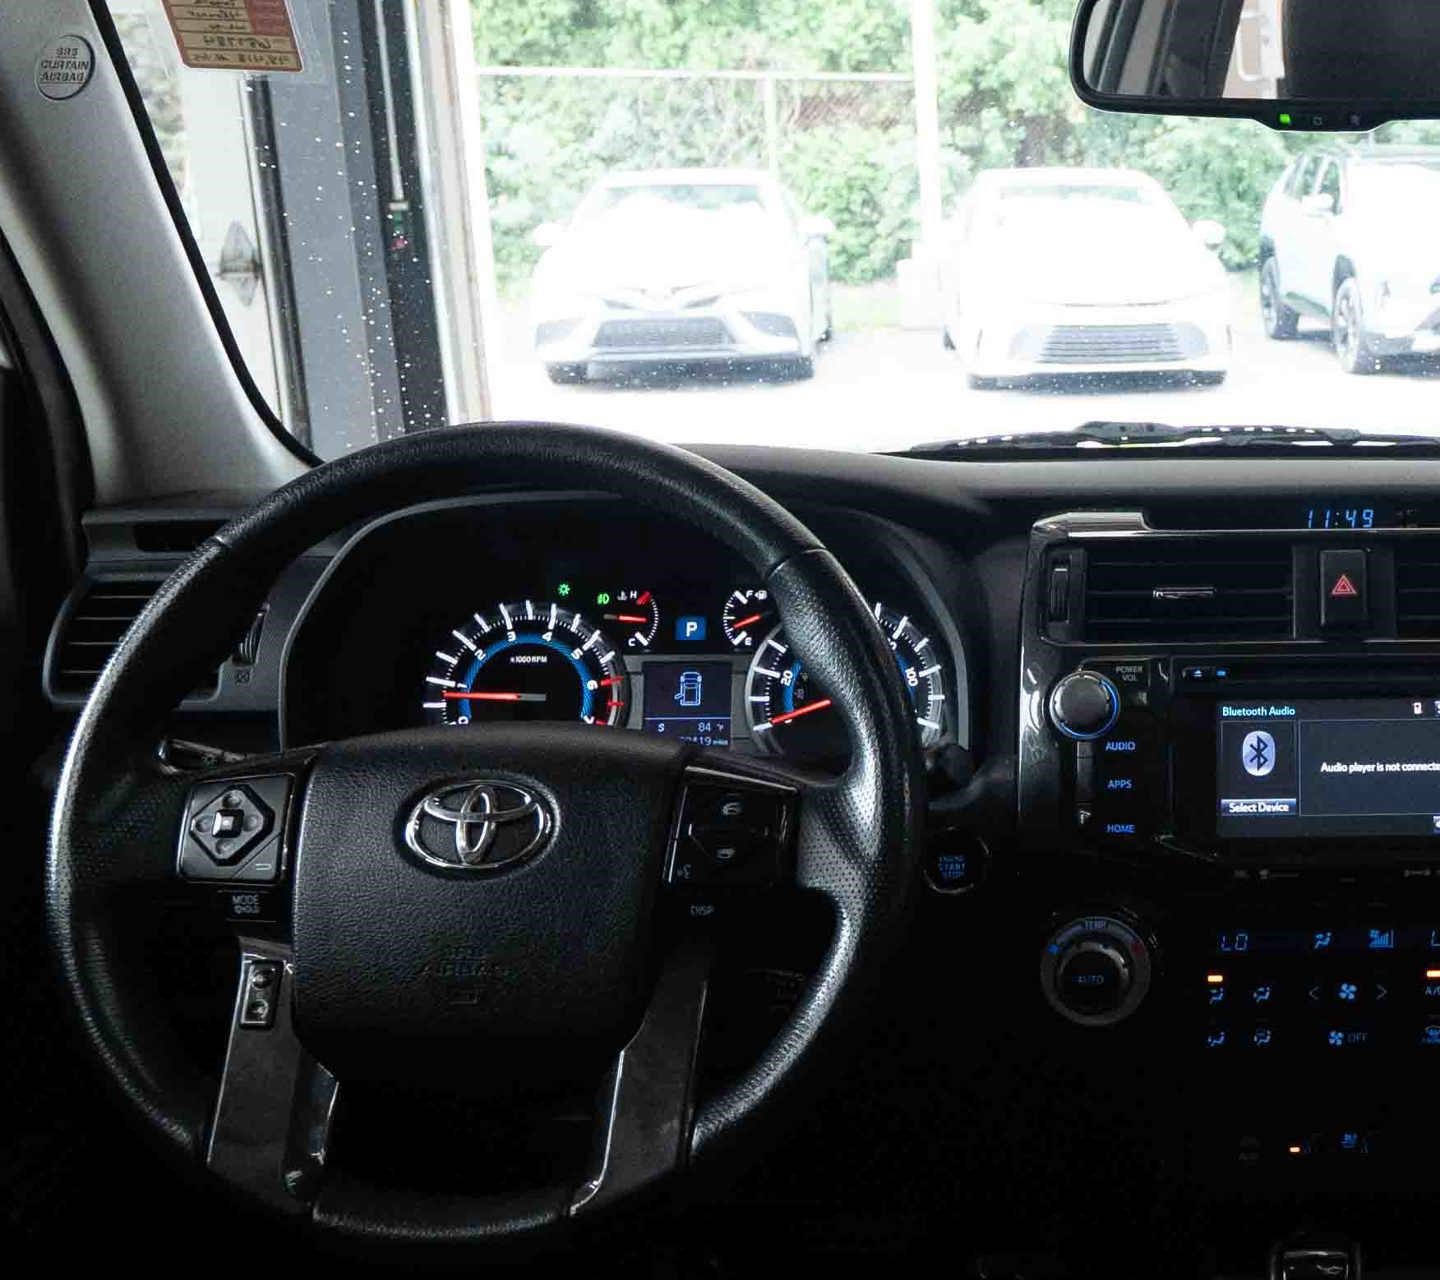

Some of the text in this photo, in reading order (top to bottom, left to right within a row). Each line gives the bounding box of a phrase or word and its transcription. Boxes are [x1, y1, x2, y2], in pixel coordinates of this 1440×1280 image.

[1307, 508, 1375, 529] 11:49
[630, 591, 637, 599] H
[746, 590, 754, 598] F
[686, 621, 698, 638] P
[508, 631, 516, 642] 3
[542, 631, 553, 642] 4
[628, 638, 636, 647] C
[475, 650, 486, 660] 2
[571, 649, 583, 660] 5
[780, 669, 793, 686] 20
[905, 666, 919, 686] 100
[587, 680, 598, 691] 6
[1222, 706, 1296, 717] Bluetooth Audio
[657, 723, 665, 733] S
[698, 722, 711, 732] 84
[1105, 740, 1137, 752] AUDIO
[1320, 762, 1348, 772] Audio
[1349, 762, 1376, 774] player
[1376, 762, 1385, 772] is
[1385, 762, 1401, 772] not
[1106, 778, 1134, 790] APPS
[1228, 801, 1290, 813] Select Device
[1105, 823, 1137, 835] HOME
